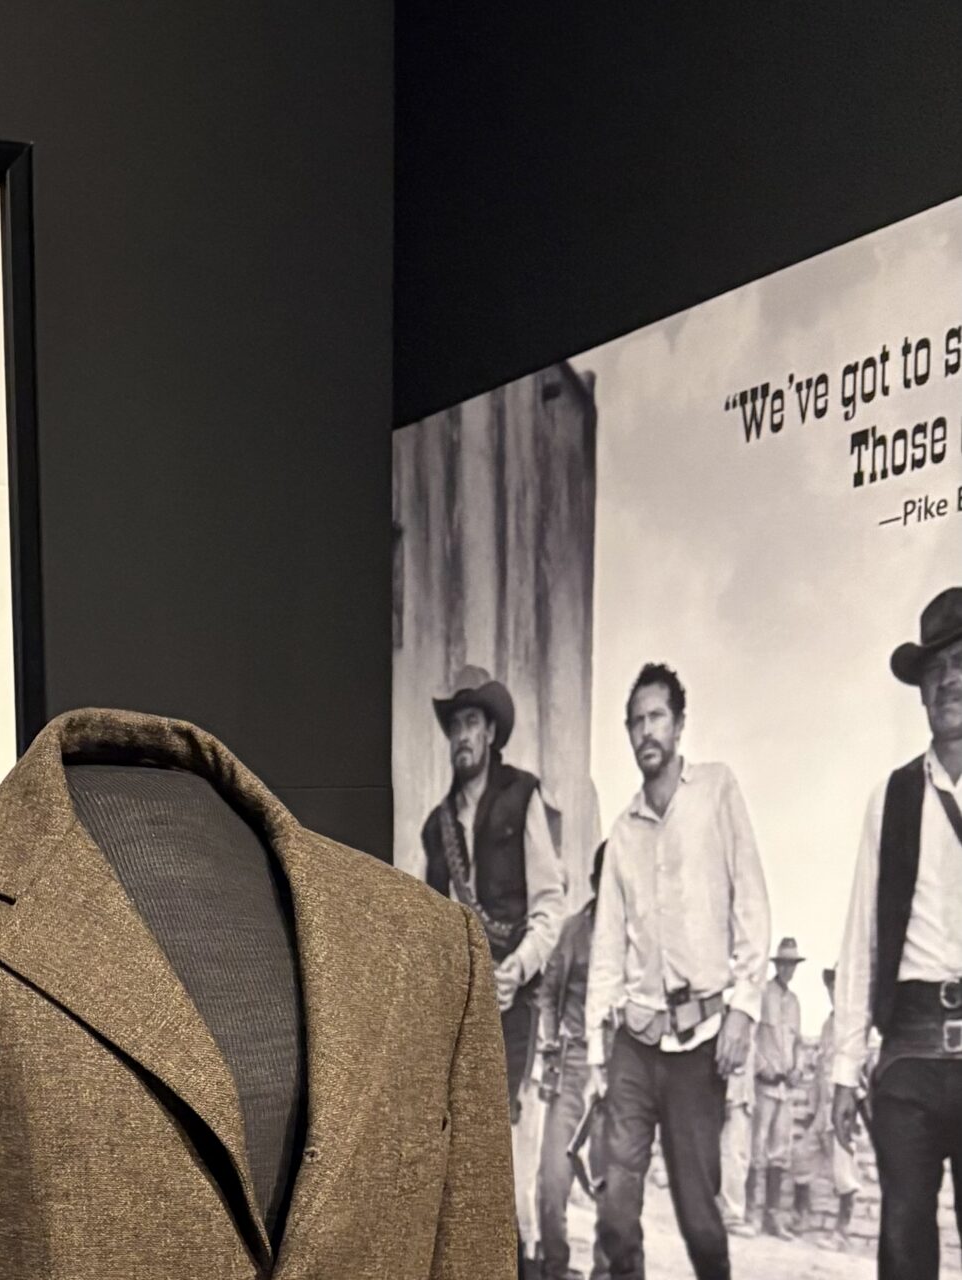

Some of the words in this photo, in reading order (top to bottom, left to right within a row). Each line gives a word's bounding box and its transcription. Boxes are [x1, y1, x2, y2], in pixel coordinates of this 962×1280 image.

[842, 345, 889, 421] got
[902, 337, 930, 389] to
[851, 416, 946, 488] Those
